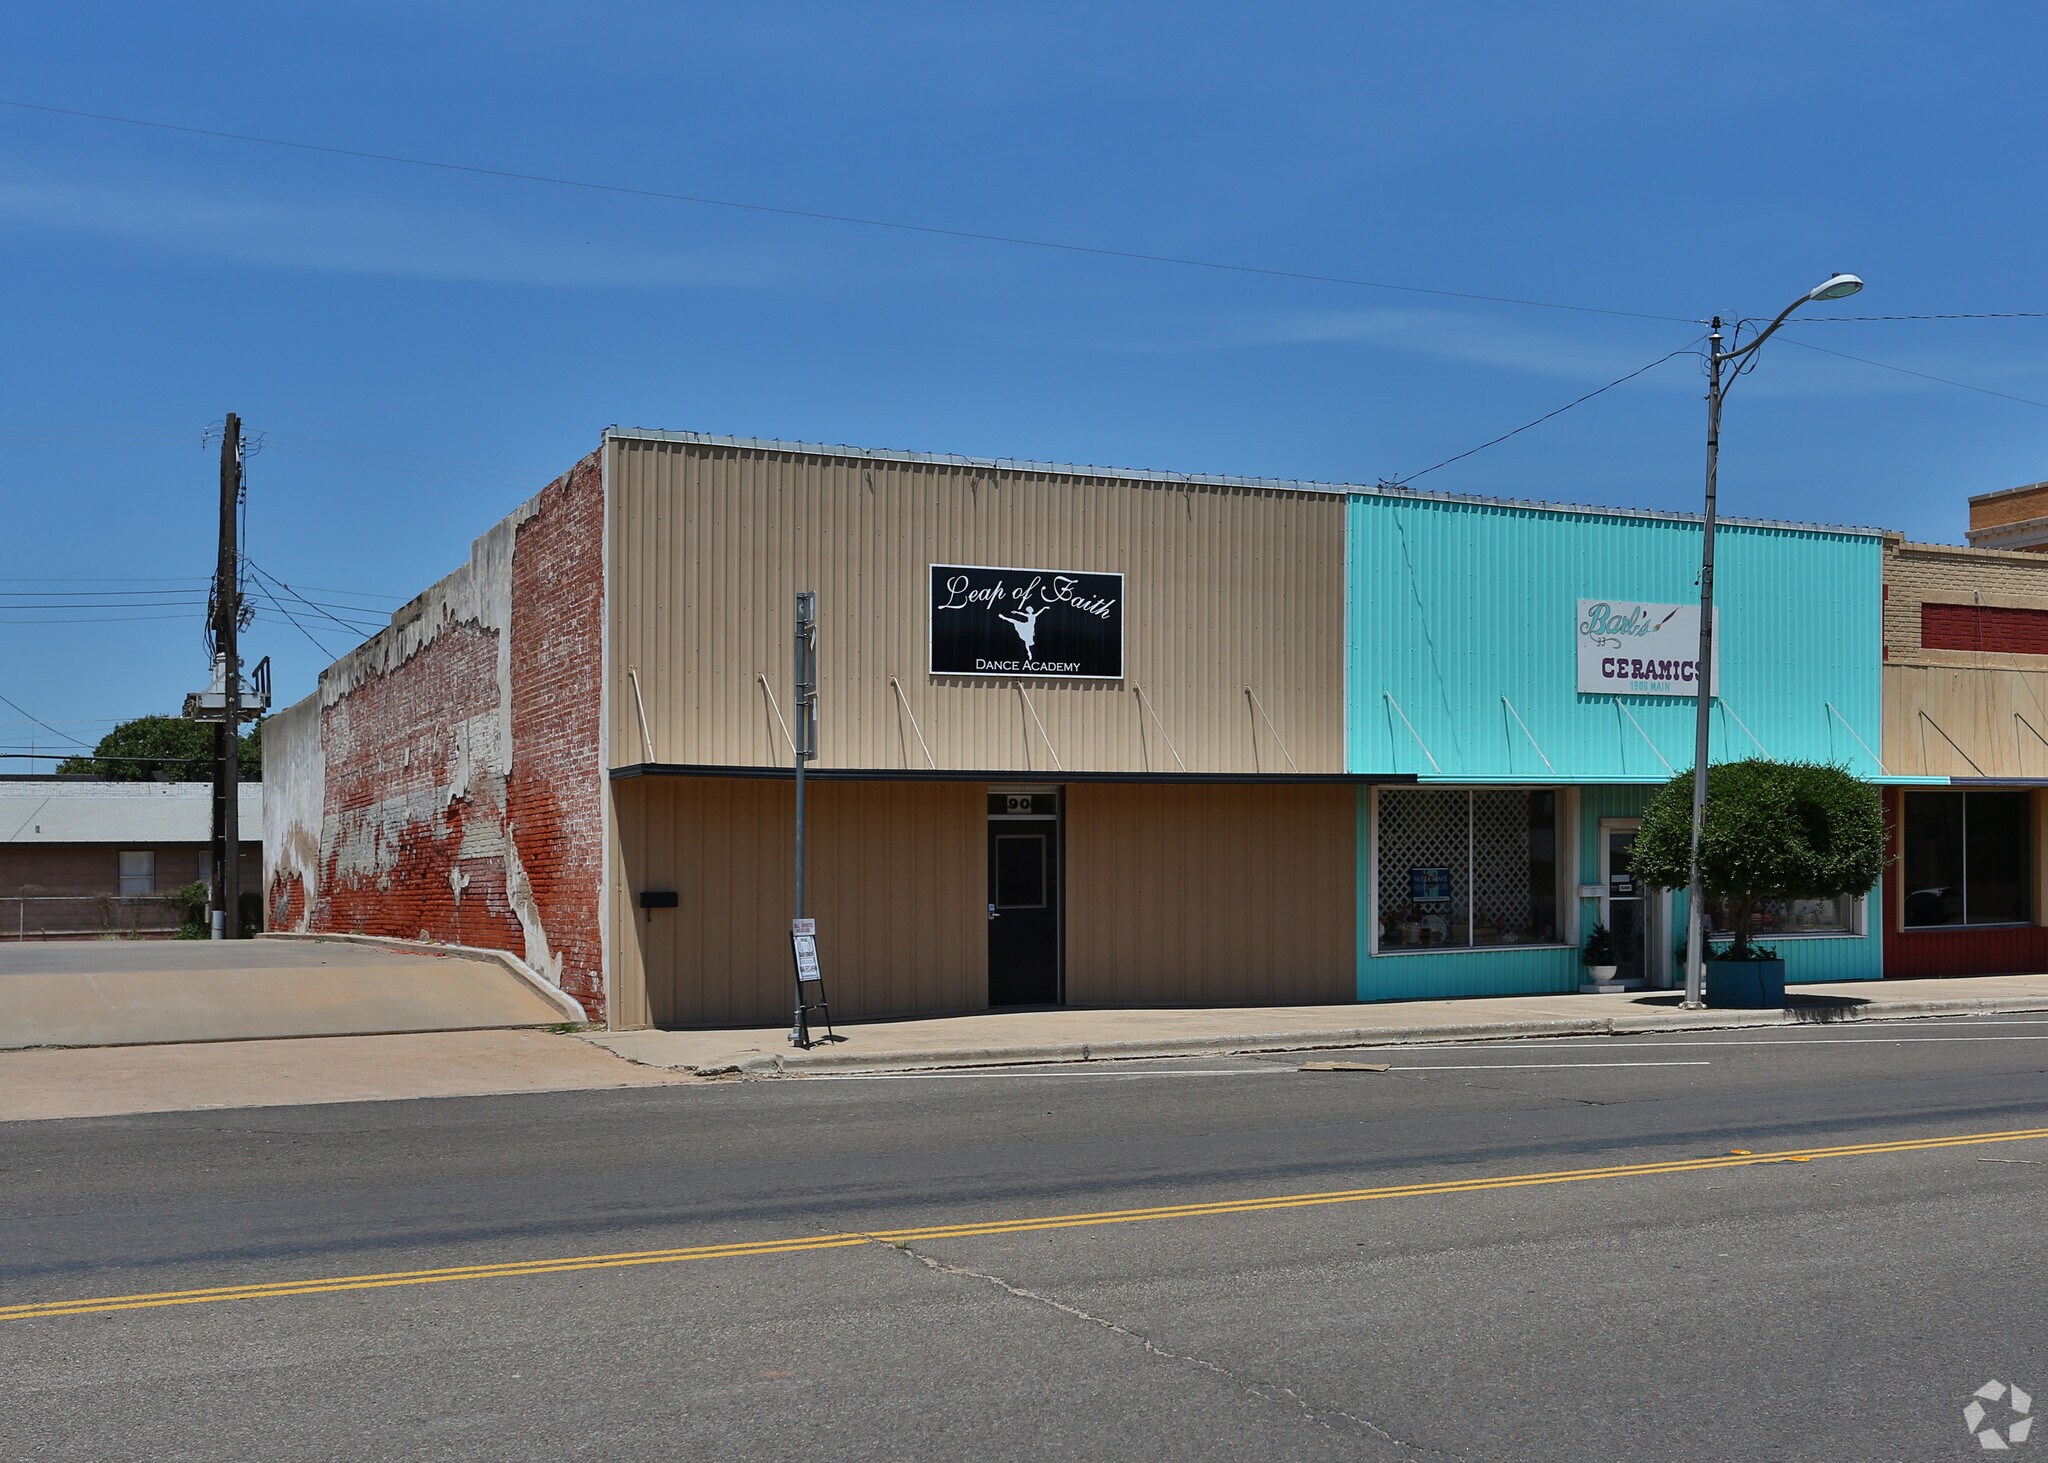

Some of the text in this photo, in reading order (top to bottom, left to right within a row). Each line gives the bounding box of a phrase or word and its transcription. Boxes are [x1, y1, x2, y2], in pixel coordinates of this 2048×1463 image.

[937, 575, 1116, 620] Leap of Faith
[1650, 681, 1670, 692] MAIN
